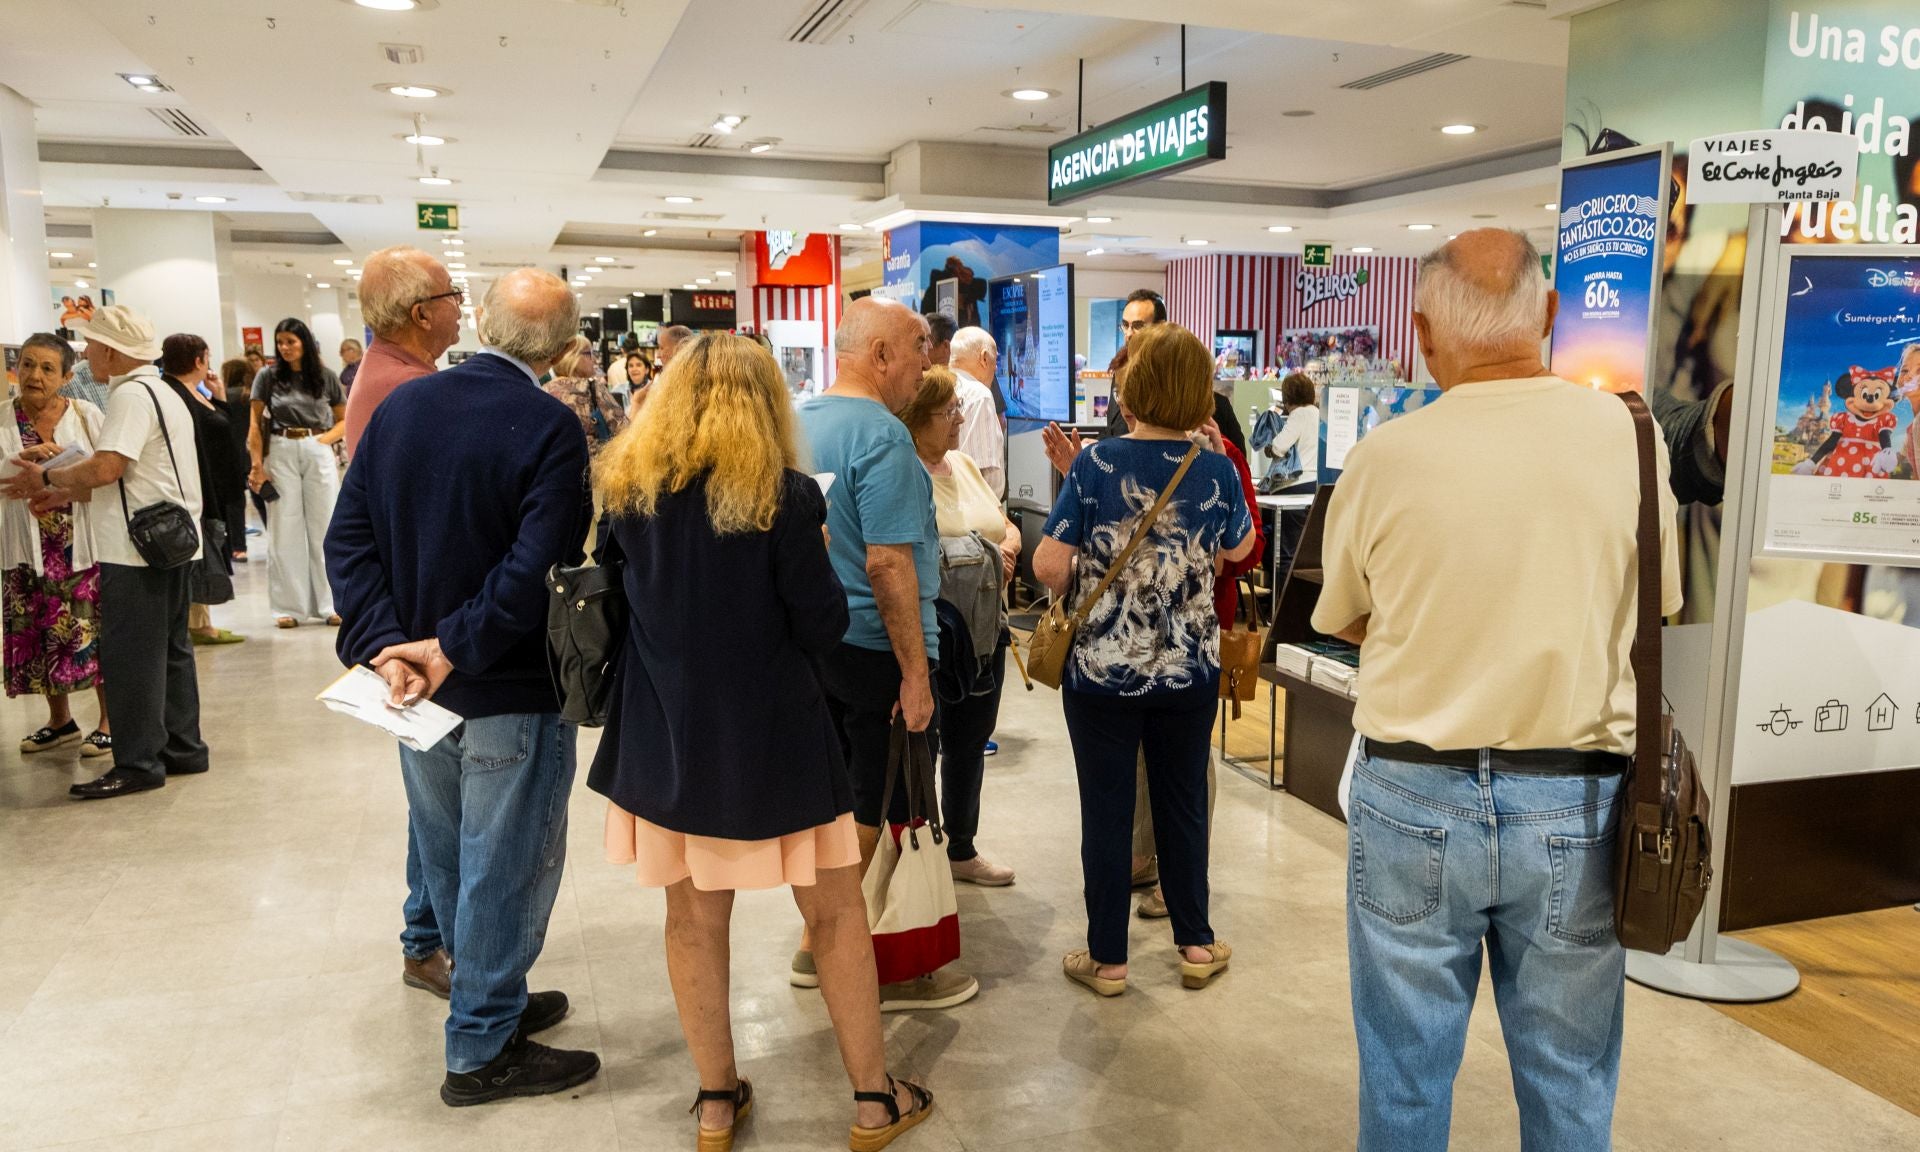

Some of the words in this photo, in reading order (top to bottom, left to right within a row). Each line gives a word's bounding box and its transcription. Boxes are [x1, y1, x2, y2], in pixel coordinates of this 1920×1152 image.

[1788, 11, 1866, 63] Una
[1877, 24, 1920, 70] so
[1841, 94, 1911, 157] ida
[1051, 138, 1119, 189] AGENCIA
[1122, 128, 1146, 167] DE
[1147, 105, 1209, 157] VIAJES
[1704, 139, 1772, 153] VIAJES
[1702, 161, 1722, 182] El
[1723, 161, 1770, 180] Corte
[1771, 155, 1843, 188] Inglés
[1580, 194, 1638, 219] CRUCERO
[1778, 190, 1813, 200] Planta
[1816, 189, 1840, 200] Baja
[1560, 217, 1623, 250] FANTÁSTICO
[1624, 217, 1655, 241] 2026
[1612, 241, 1619, 251] TU
[1619, 241, 1648, 257] CRUCERO
[1584, 271, 1605, 282] AHORRA
[1605, 271, 1623, 281] HASTA
[1296, 271, 1359, 312] BELROS
[1585, 280, 1620, 309] 60%
[1844, 312, 1898, 324] Sumérgete
[1852, 511, 1878, 524] 85€
